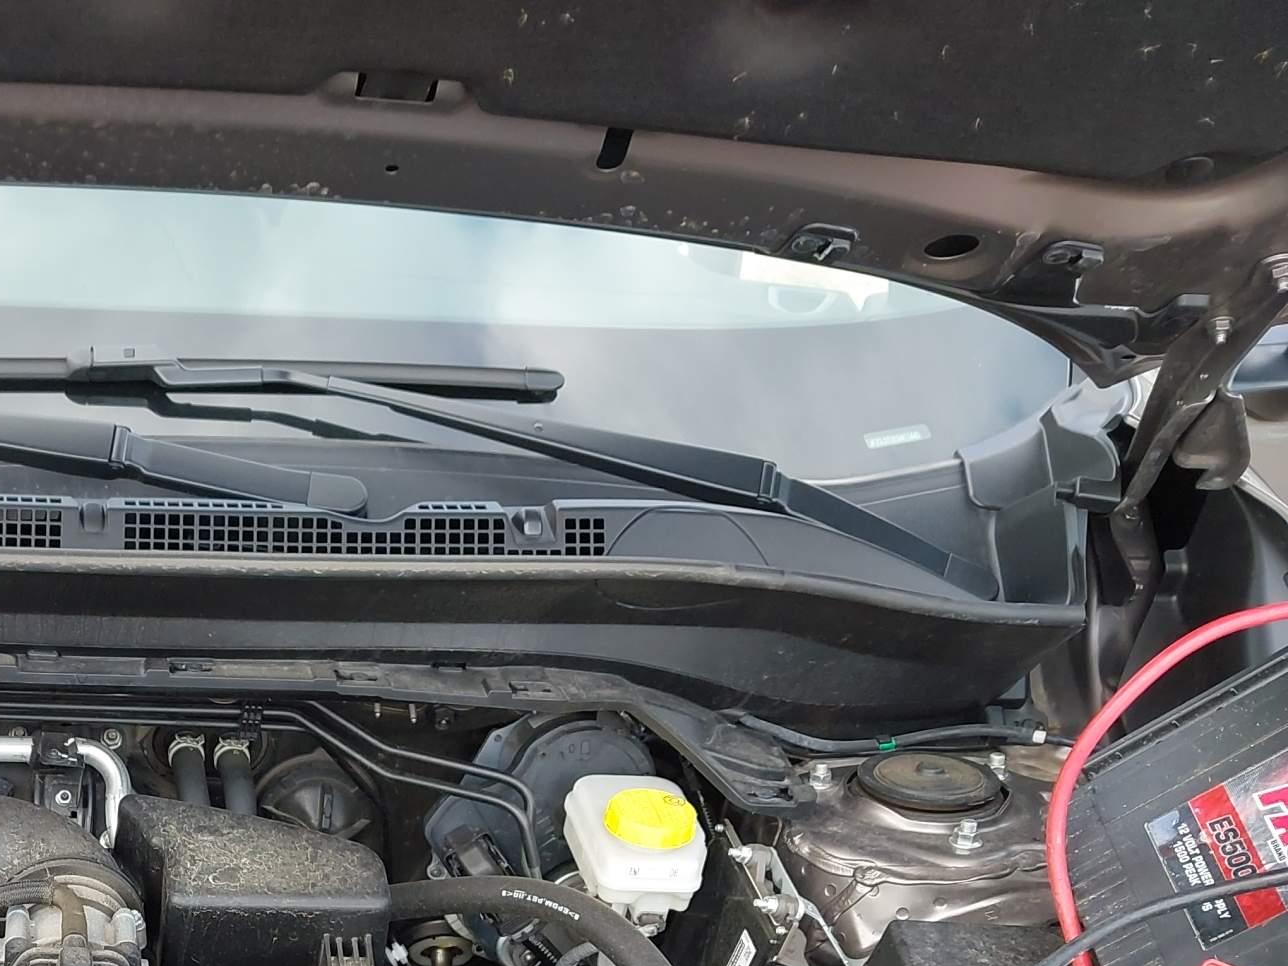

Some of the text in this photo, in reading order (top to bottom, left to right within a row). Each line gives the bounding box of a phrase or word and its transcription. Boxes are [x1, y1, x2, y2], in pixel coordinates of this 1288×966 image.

[1177, 823, 1190, 835] 12
[1182, 834, 1200, 857] VOLT
[1173, 841, 1201, 887] 1500 PEAK
[1191, 855, 1215, 887] POWER
